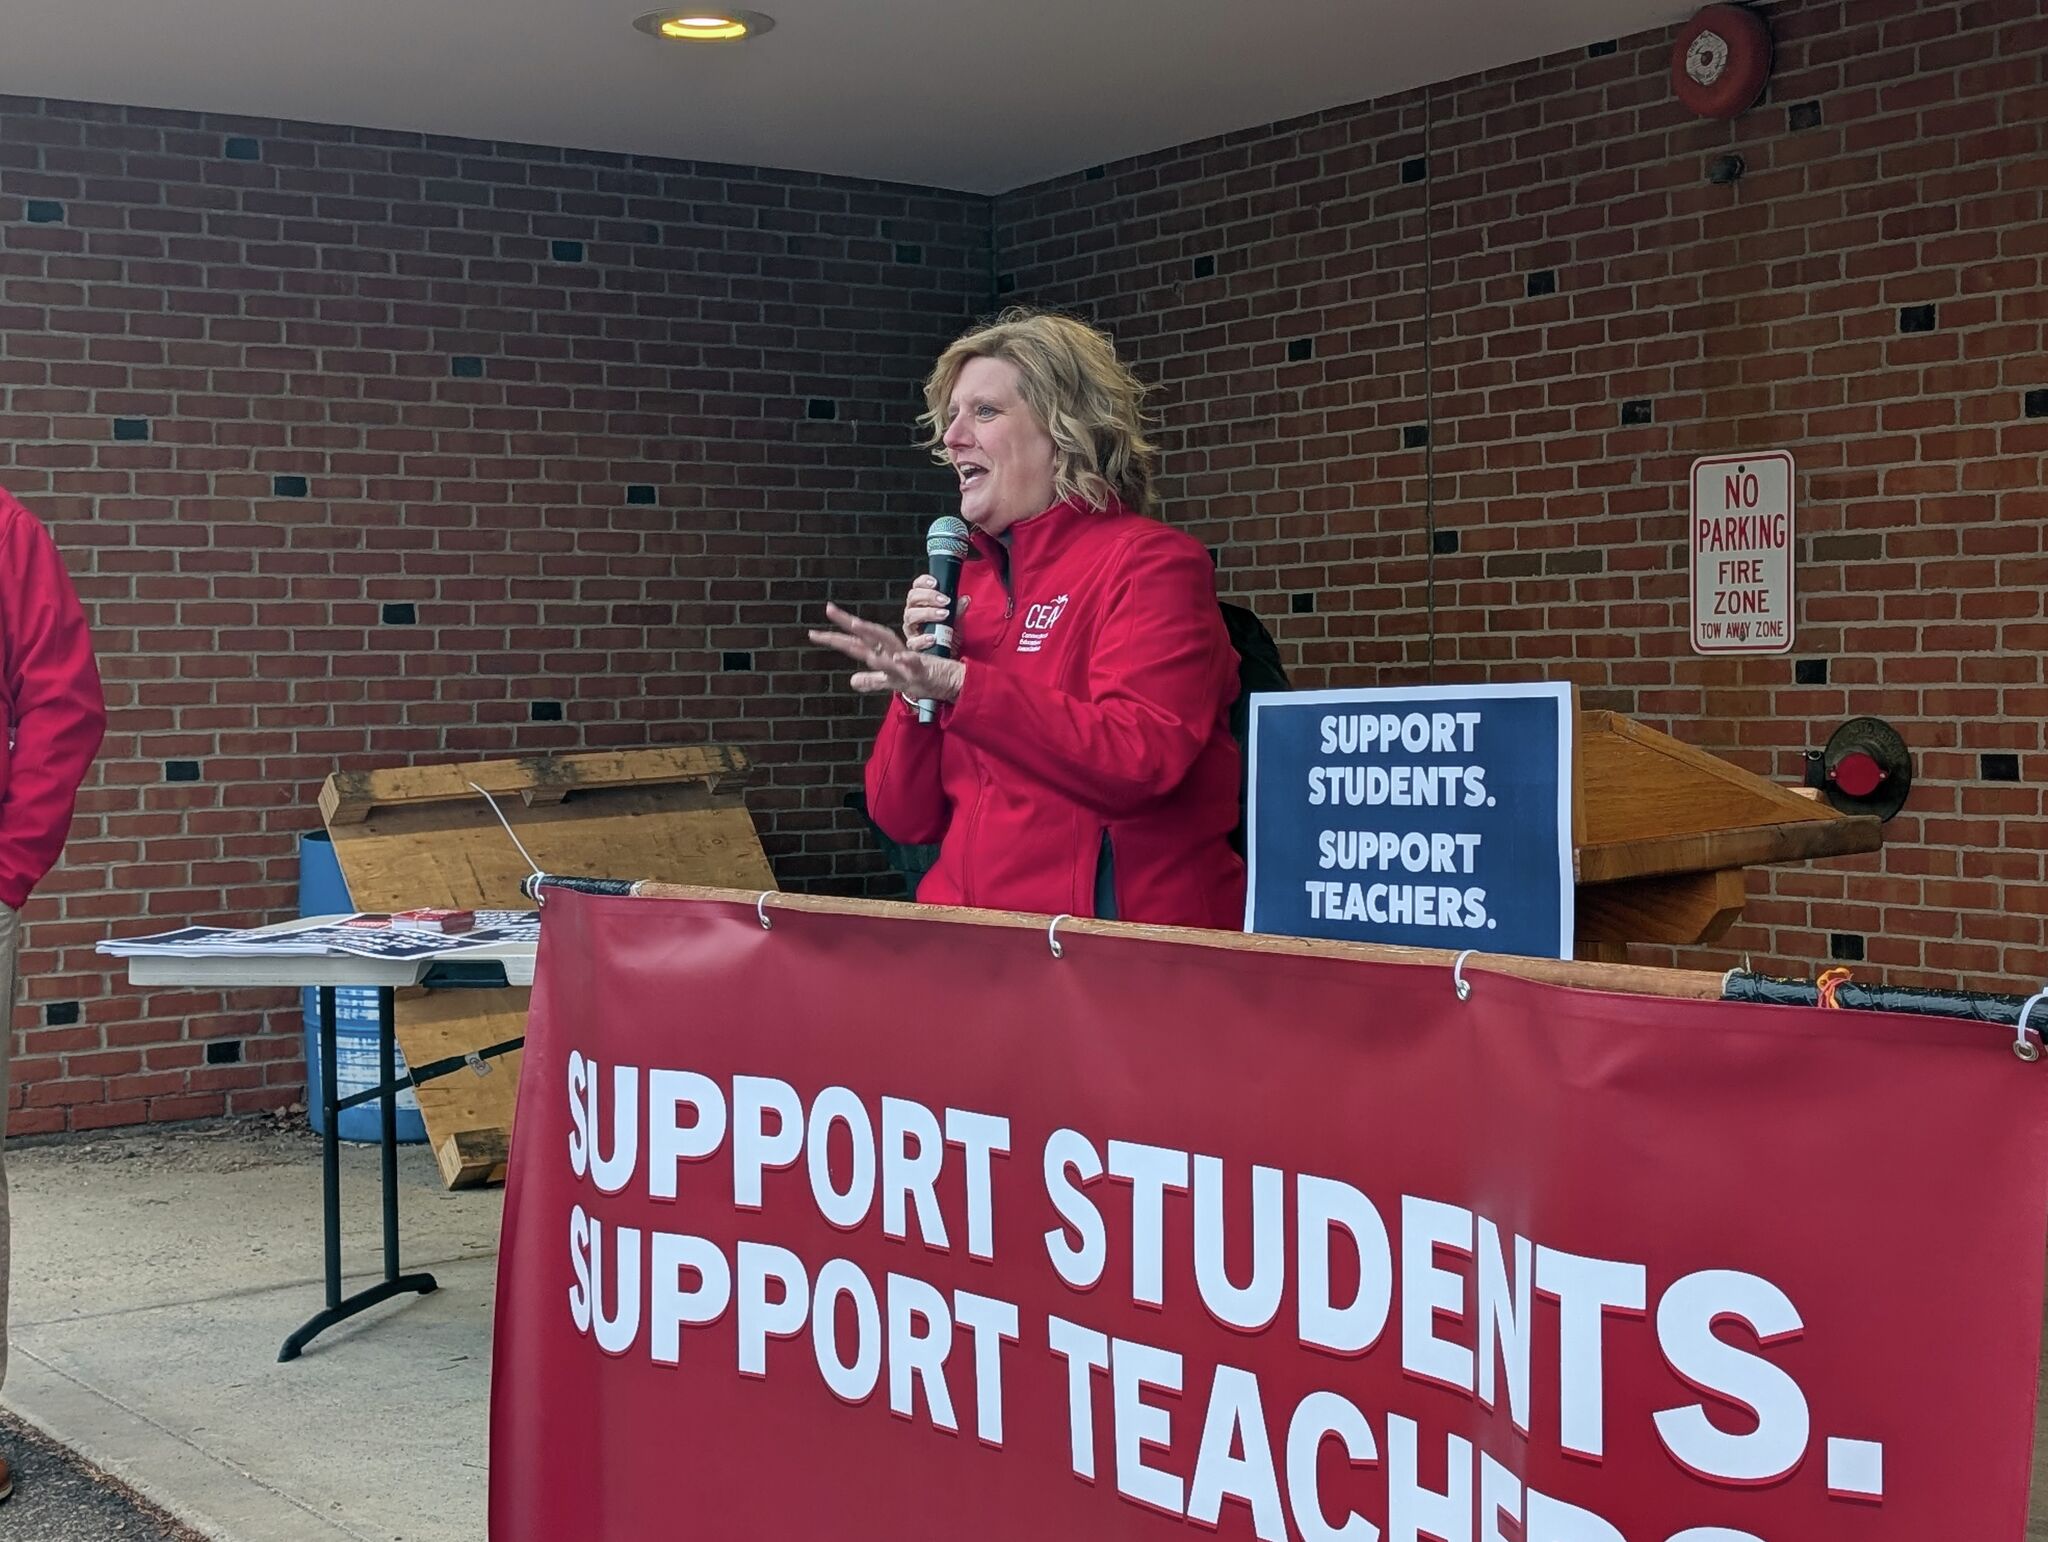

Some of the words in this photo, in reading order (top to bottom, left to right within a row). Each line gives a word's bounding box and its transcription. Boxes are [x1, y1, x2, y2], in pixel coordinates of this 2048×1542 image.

[1725, 474, 1759, 510] NO
[1699, 513, 1786, 553] PARKING
[1718, 559, 1764, 585] FIRE
[1025, 601, 1063, 629] CEA
[1713, 589, 1770, 615] ZONE
[1700, 622, 1722, 640] TOW
[1725, 621, 1752, 639] AWAY
[1755, 620, 1784, 638] ZONE
[1320, 712, 1481, 754] SUPPORT
[1308, 765, 1496, 807] STUDENTS.
[1318, 830, 1482, 873] SUPPORT
[1305, 880, 1497, 930] TEACHERS.
[567, 1049, 1011, 1262] SUPPORT
[1043, 1127, 1884, 1498] STUDENTS.
[568, 1203, 1020, 1447] SUPPORT
